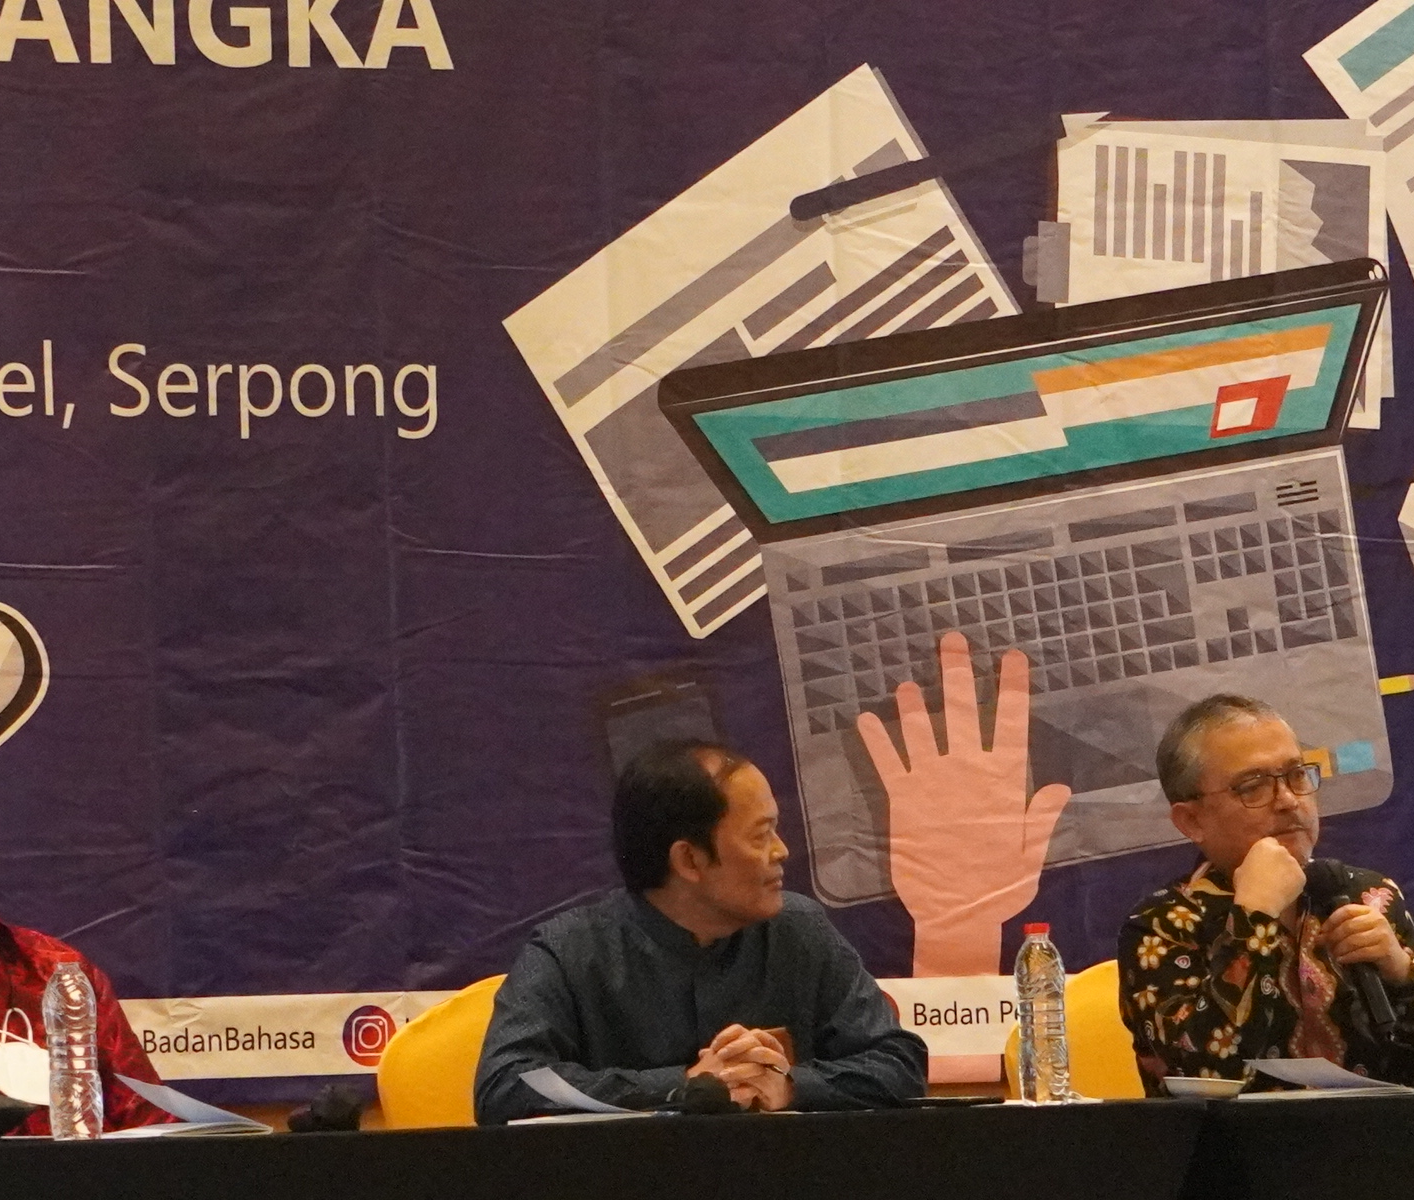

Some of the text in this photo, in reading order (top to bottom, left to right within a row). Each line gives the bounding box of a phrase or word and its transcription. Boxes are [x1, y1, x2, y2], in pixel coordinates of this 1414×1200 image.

[109, 344, 438, 440] Serpong
[914, 1001, 989, 1026] Badan
[143, 1025, 315, 1053] BadanBahasa
